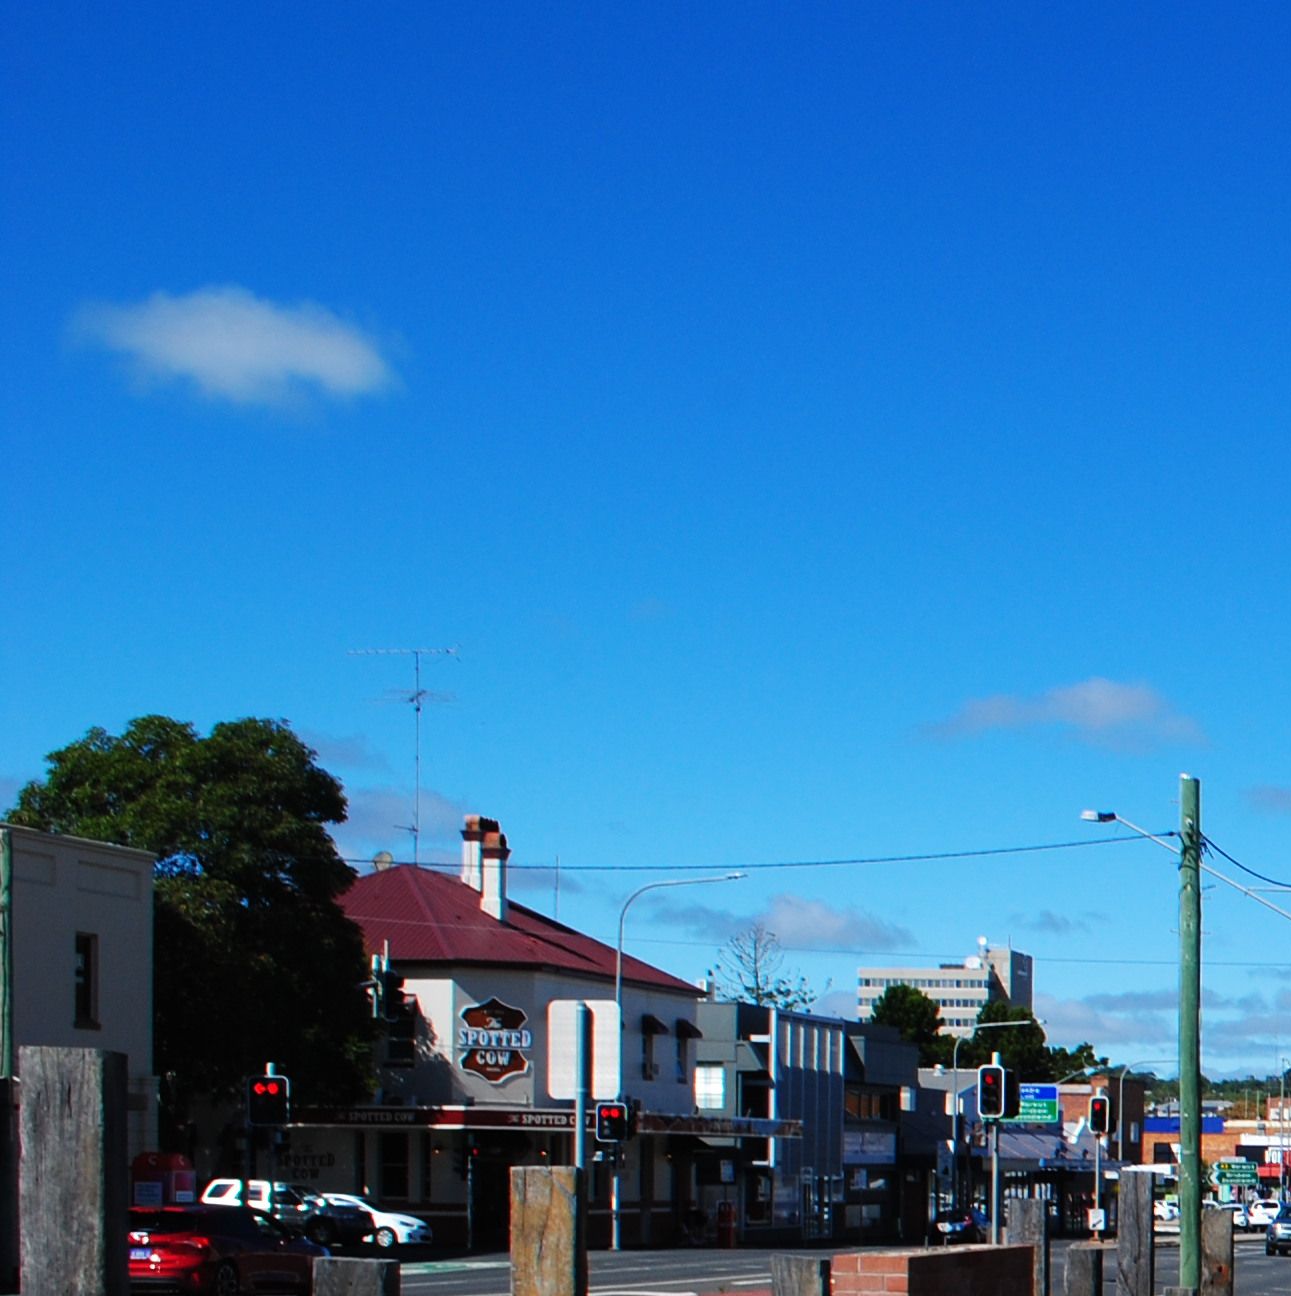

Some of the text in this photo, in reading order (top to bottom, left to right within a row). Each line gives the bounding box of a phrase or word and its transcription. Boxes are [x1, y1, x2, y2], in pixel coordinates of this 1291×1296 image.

[459, 1027, 532, 1048] SPOTTED
[475, 1050, 511, 1067] COW
[348, 1110, 393, 1123] SPOTTED
[393, 1111, 416, 1123] COW
[521, 1113, 568, 1126] SPOTTED
